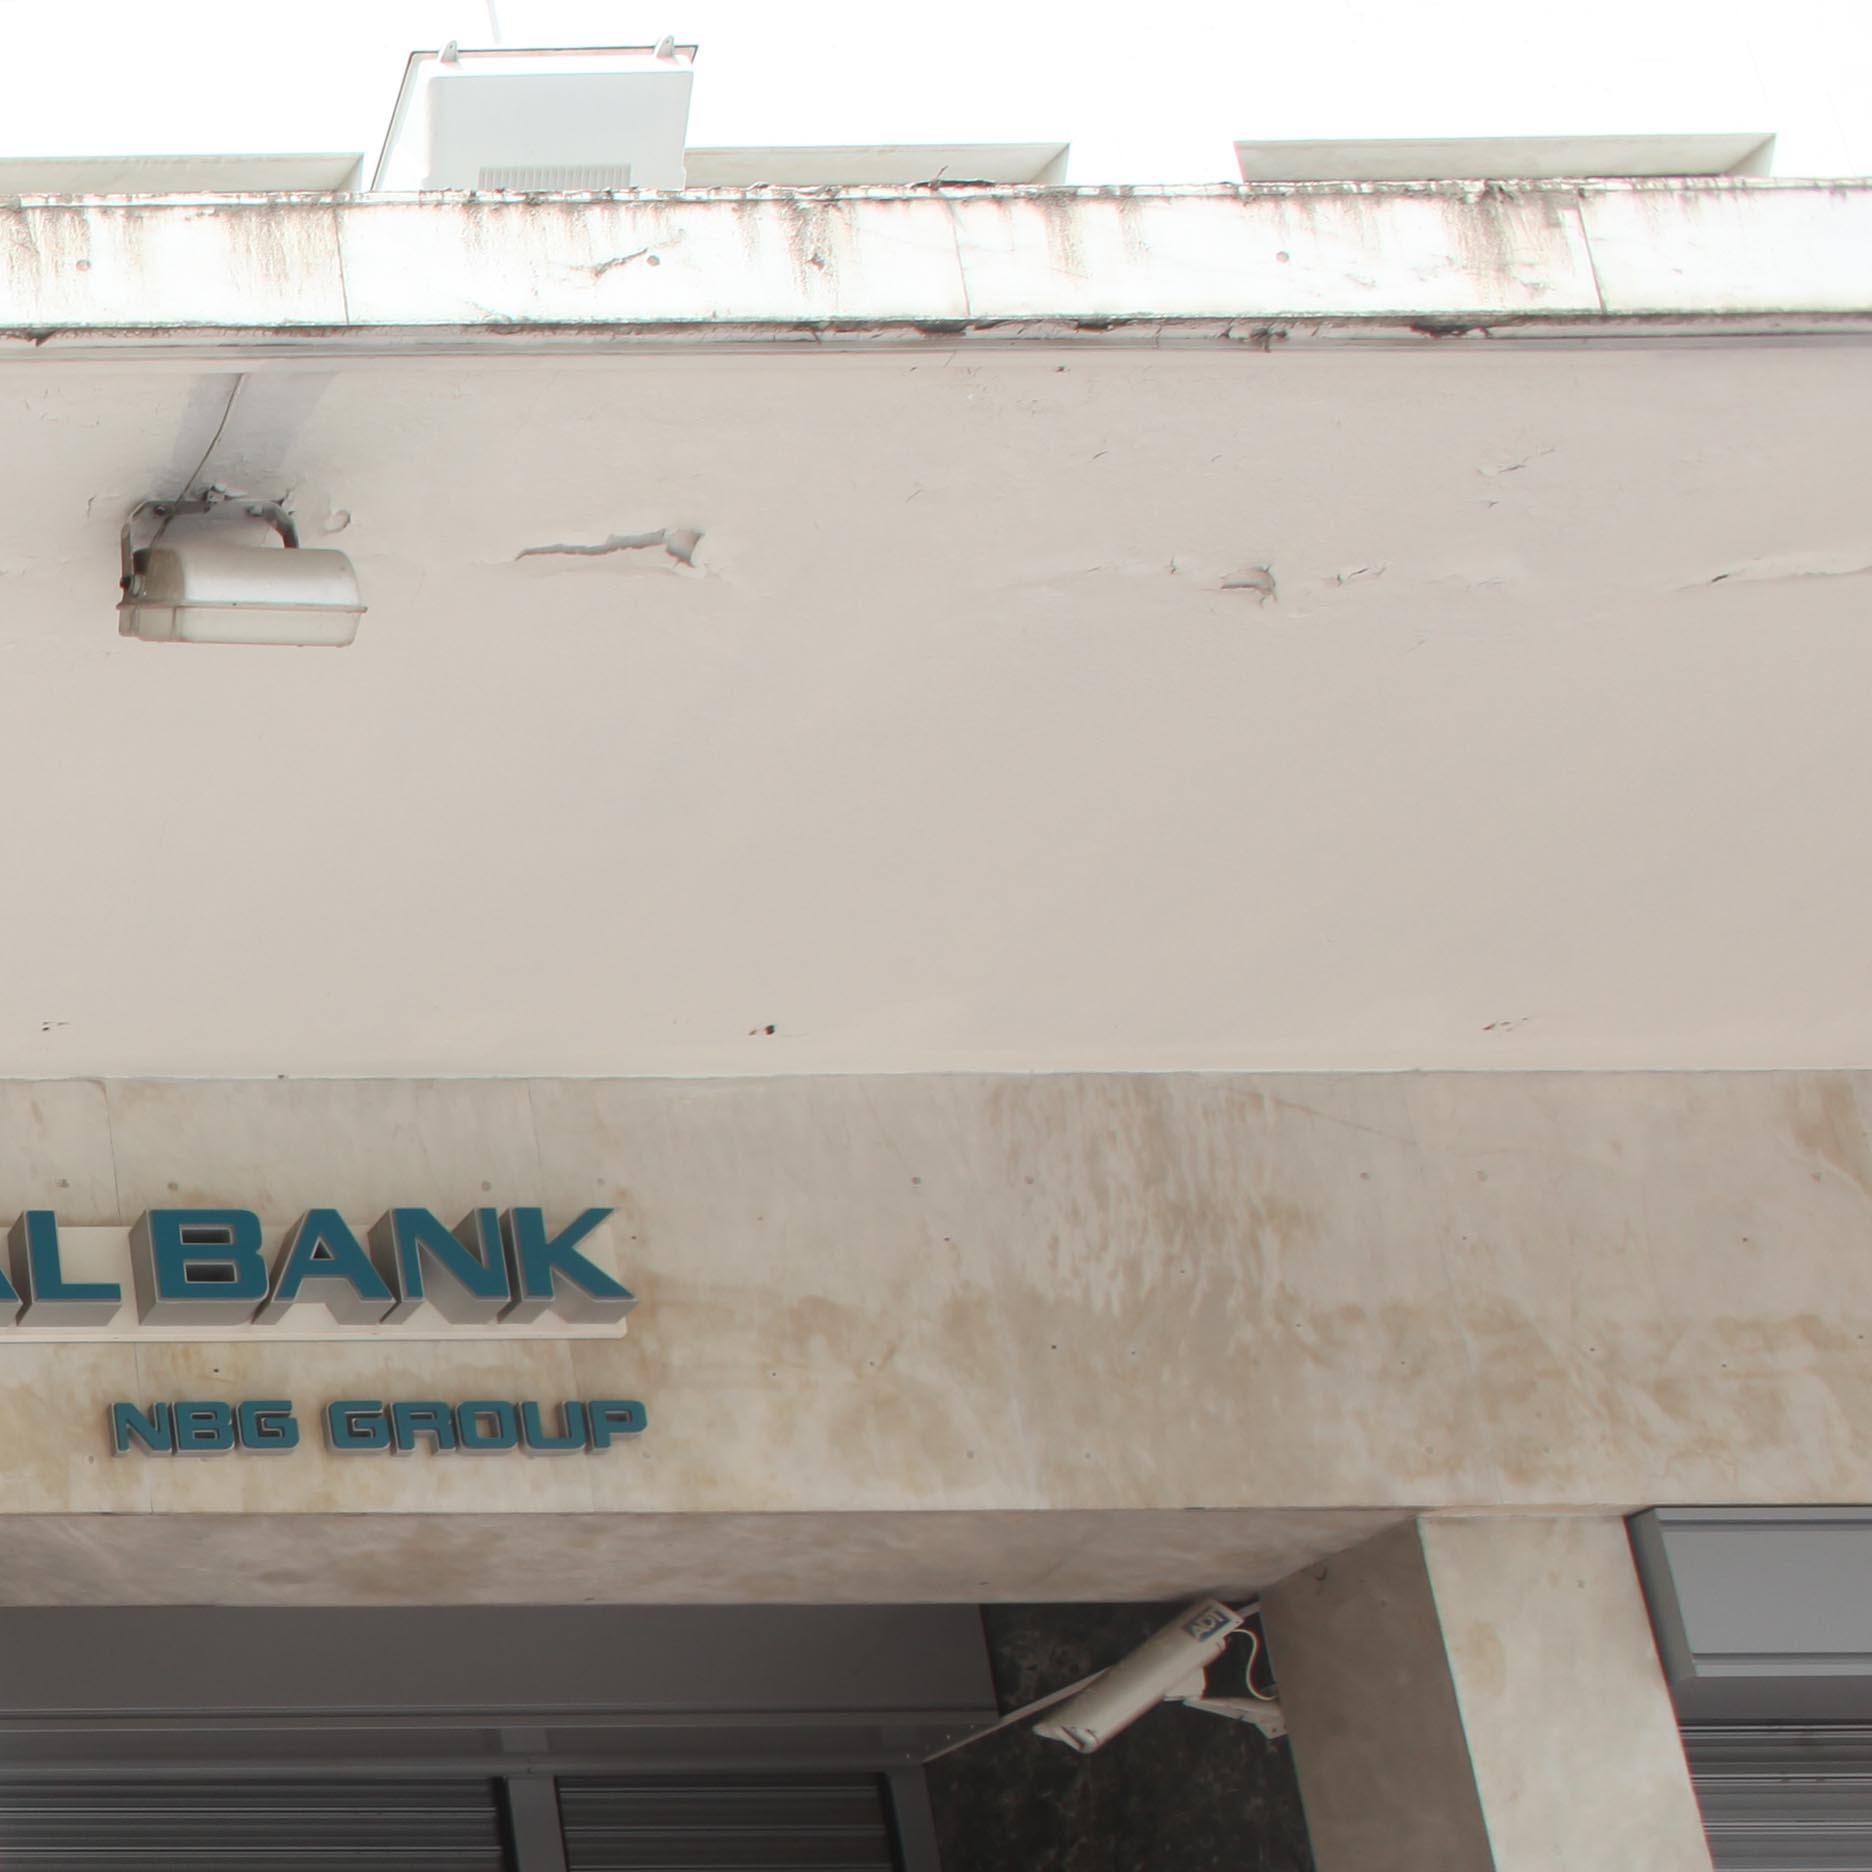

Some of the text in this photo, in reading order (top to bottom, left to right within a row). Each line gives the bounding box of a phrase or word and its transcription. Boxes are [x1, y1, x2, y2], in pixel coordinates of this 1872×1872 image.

[142, 1206, 636, 1308] BANK
[112, 1399, 652, 1454] NBG GROUP
